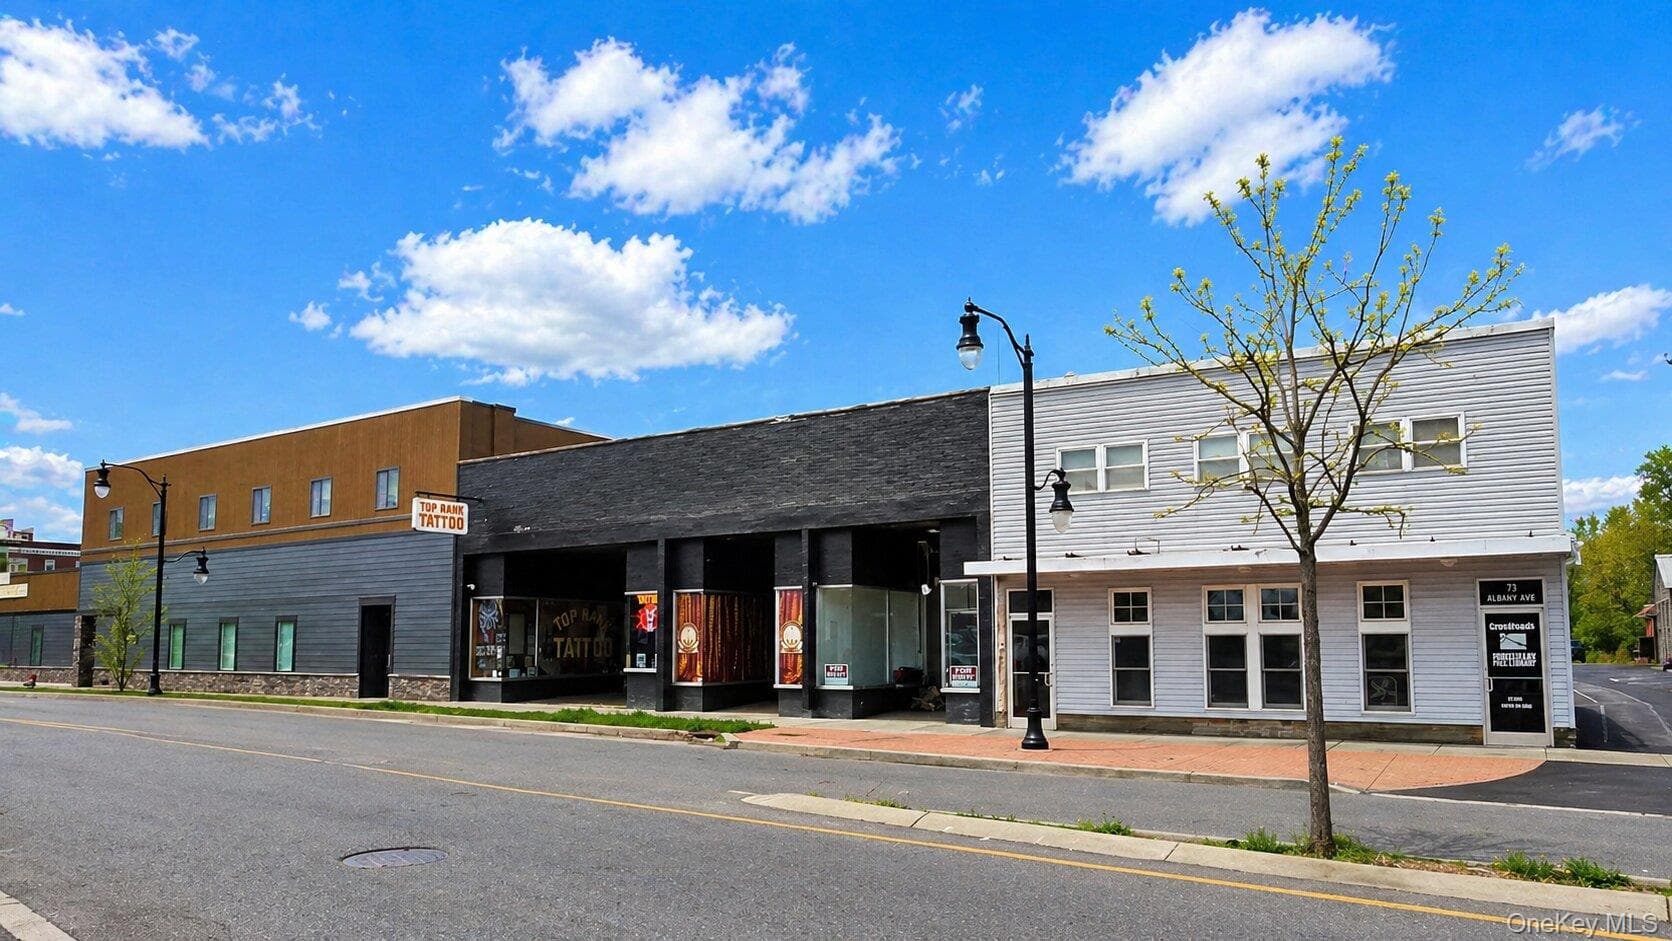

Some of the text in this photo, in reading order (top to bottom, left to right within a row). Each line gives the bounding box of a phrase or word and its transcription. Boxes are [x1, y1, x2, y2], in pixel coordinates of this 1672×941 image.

[419, 501, 464, 515] TOP RANK
[418, 513, 464, 530] TATTOO
[1506, 583, 1517, 592] 73
[1487, 593, 1536, 602] ALBANY AVE
[553, 609, 578, 631] TOP
[553, 637, 612, 658] TATTOO
